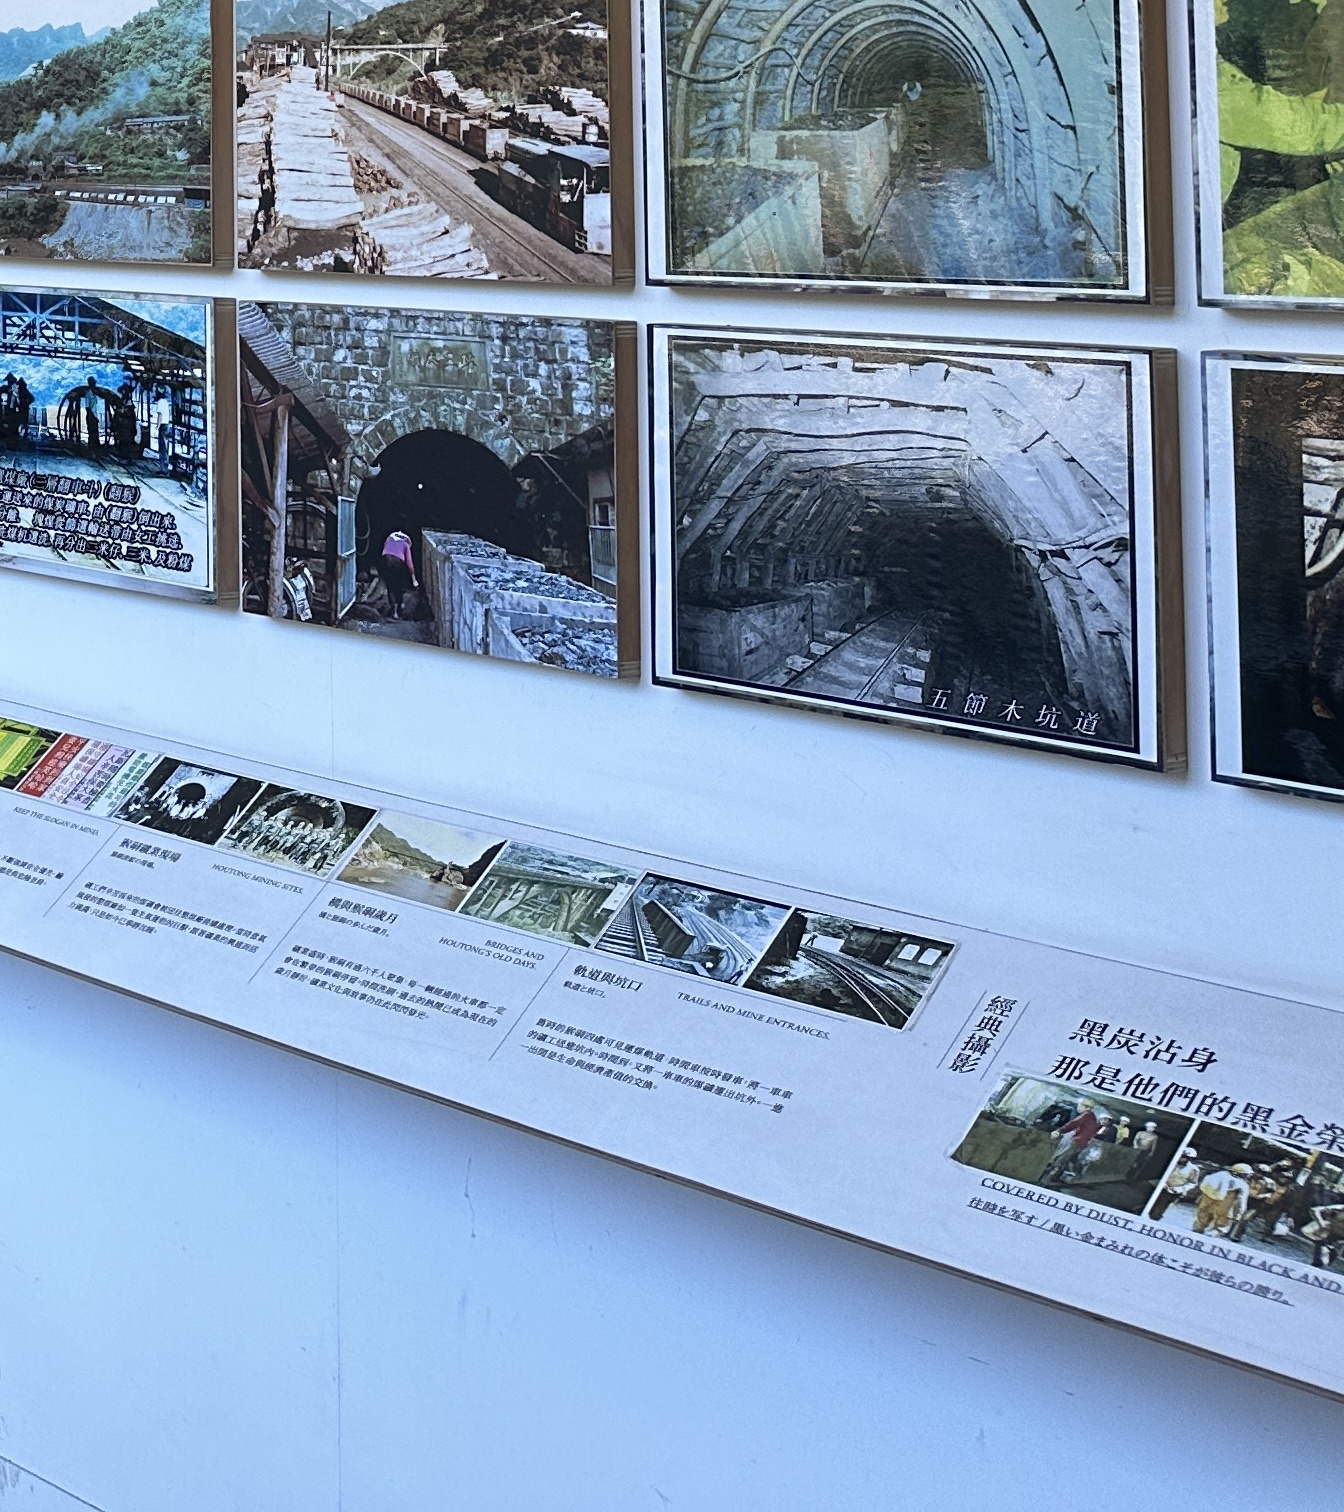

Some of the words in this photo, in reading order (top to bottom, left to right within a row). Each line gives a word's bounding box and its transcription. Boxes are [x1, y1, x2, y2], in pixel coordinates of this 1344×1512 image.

[927, 687, 1100, 735] 五節木坑道
[484, 939, 524, 956] BRIDGES
[522, 948, 545, 962] AND
[492, 952, 513, 964] OLD
[573, 964, 643, 992] 軌道與坑口
[677, 991, 711, 1008] TRAILS
[711, 1001, 736, 1013] AND
[737, 1007, 766, 1023] MINE
[948, 994, 1018, 1076] 經典攝影
[1068, 1018, 1219, 1073] 黑炭沾身
[980, 1176, 1060, 1209] COVERED
[1063, 1201, 1084, 1214] BY
[1139, 1223, 1205, 1252] HONOR
[1209, 1244, 1232, 1259] IN
[1235, 1252, 1295, 1279] BLACK
[1298, 1270, 1343, 1293] AND
